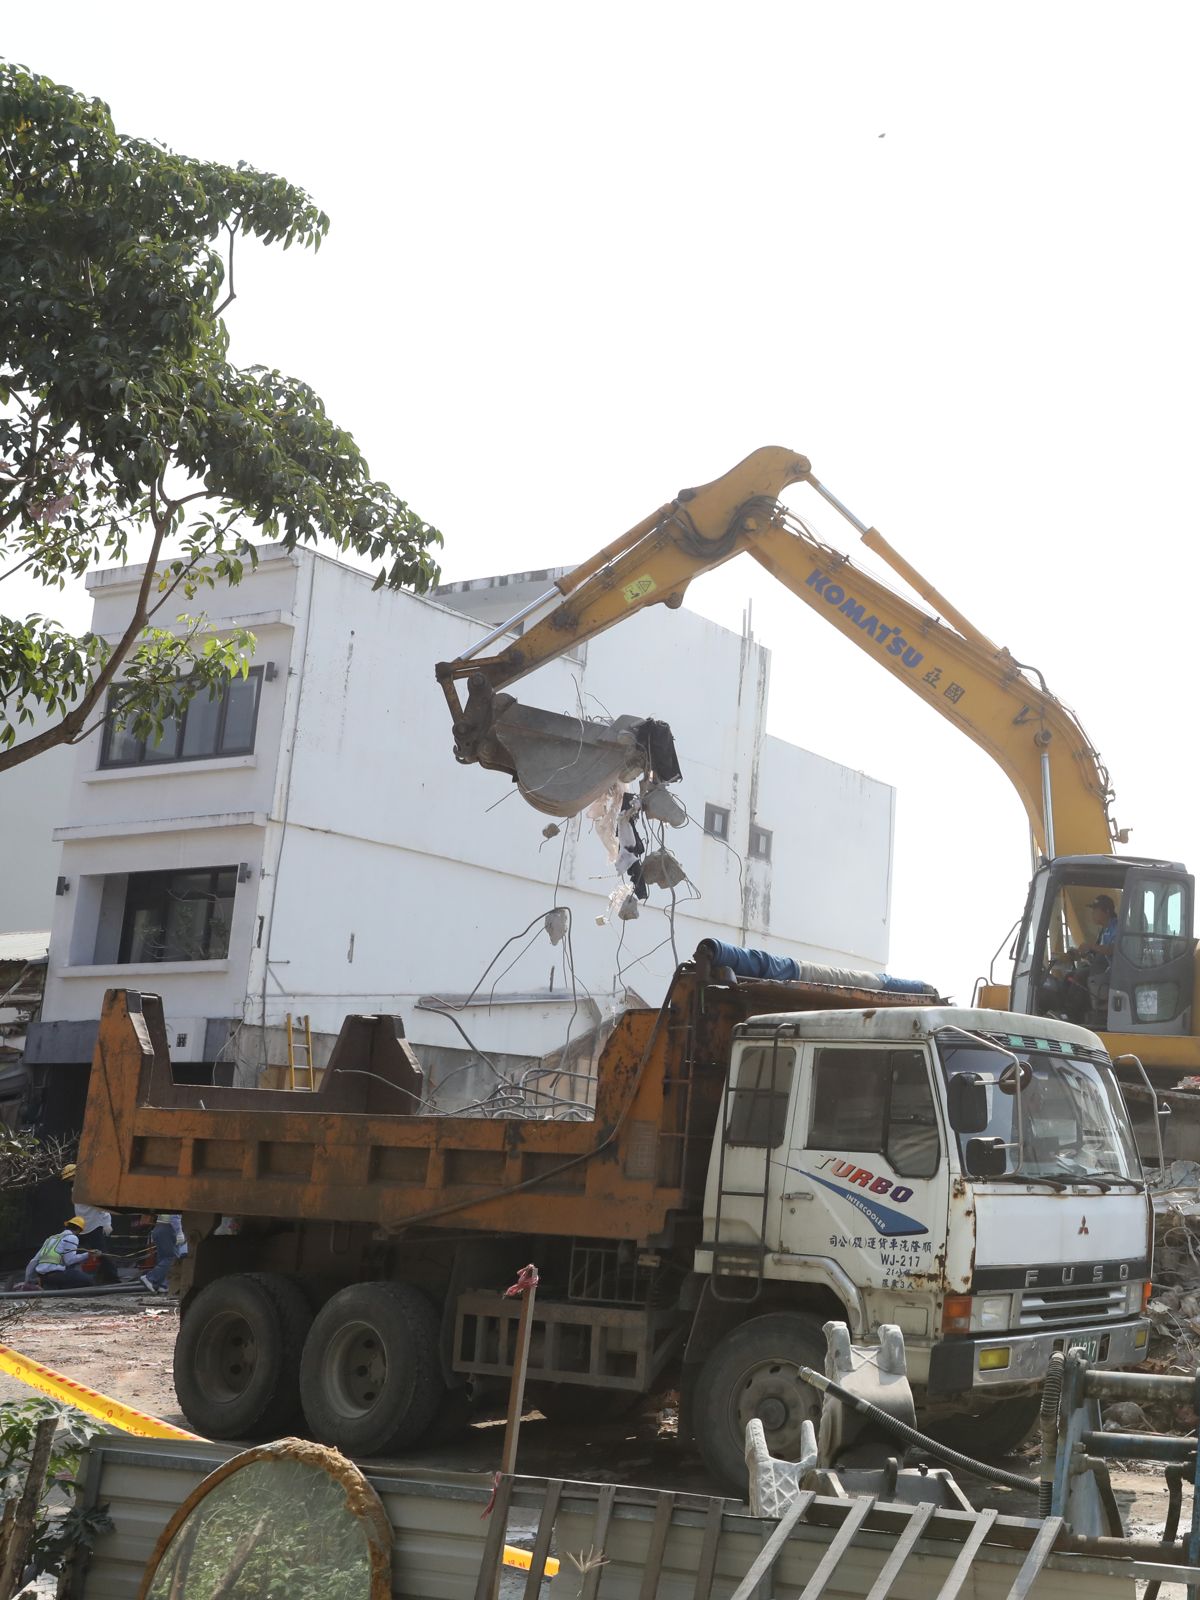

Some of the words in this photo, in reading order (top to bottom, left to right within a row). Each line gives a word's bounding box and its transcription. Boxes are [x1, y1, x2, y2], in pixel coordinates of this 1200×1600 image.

[805, 568, 924, 669] KOMATSU
[814, 1154, 915, 1203] TURBO
[846, 1193, 886, 1229] INTERCOOLER
[880, 1253, 921, 1268] WJ-217
[1024, 1263, 1129, 1289] FUSO
